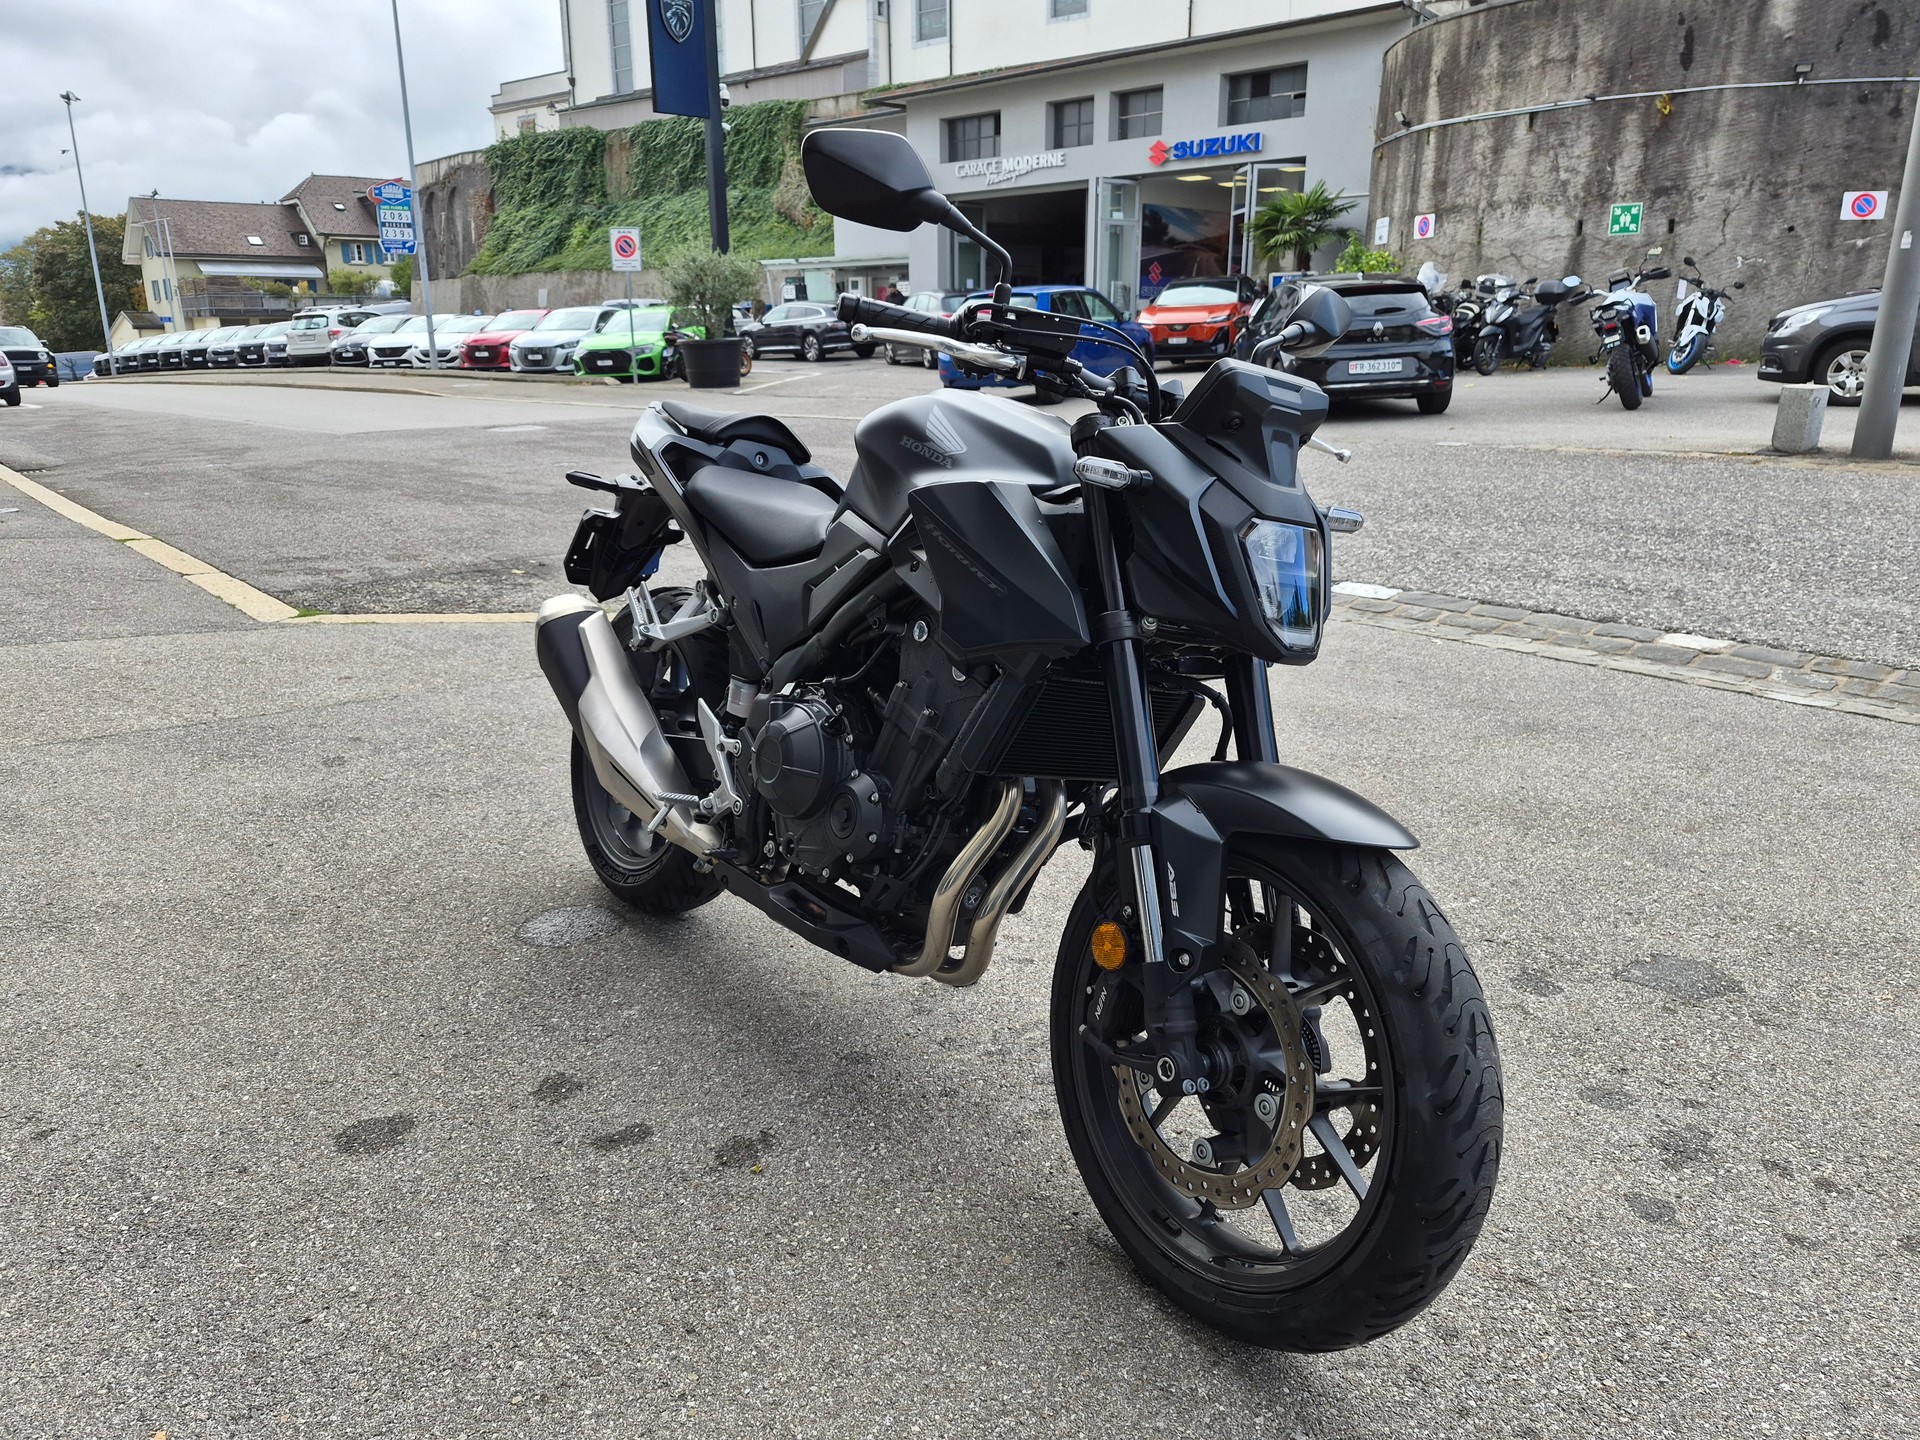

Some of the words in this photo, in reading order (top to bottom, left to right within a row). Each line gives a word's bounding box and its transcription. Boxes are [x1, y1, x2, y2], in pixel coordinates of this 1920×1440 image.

[1173, 132, 1262, 159] SUZUKI
[954, 160, 999, 177] GARAGE
[1001, 152, 1065, 172] MODERNE
[899, 434, 953, 469] HONDA
[1167, 860, 1180, 918] ABS
